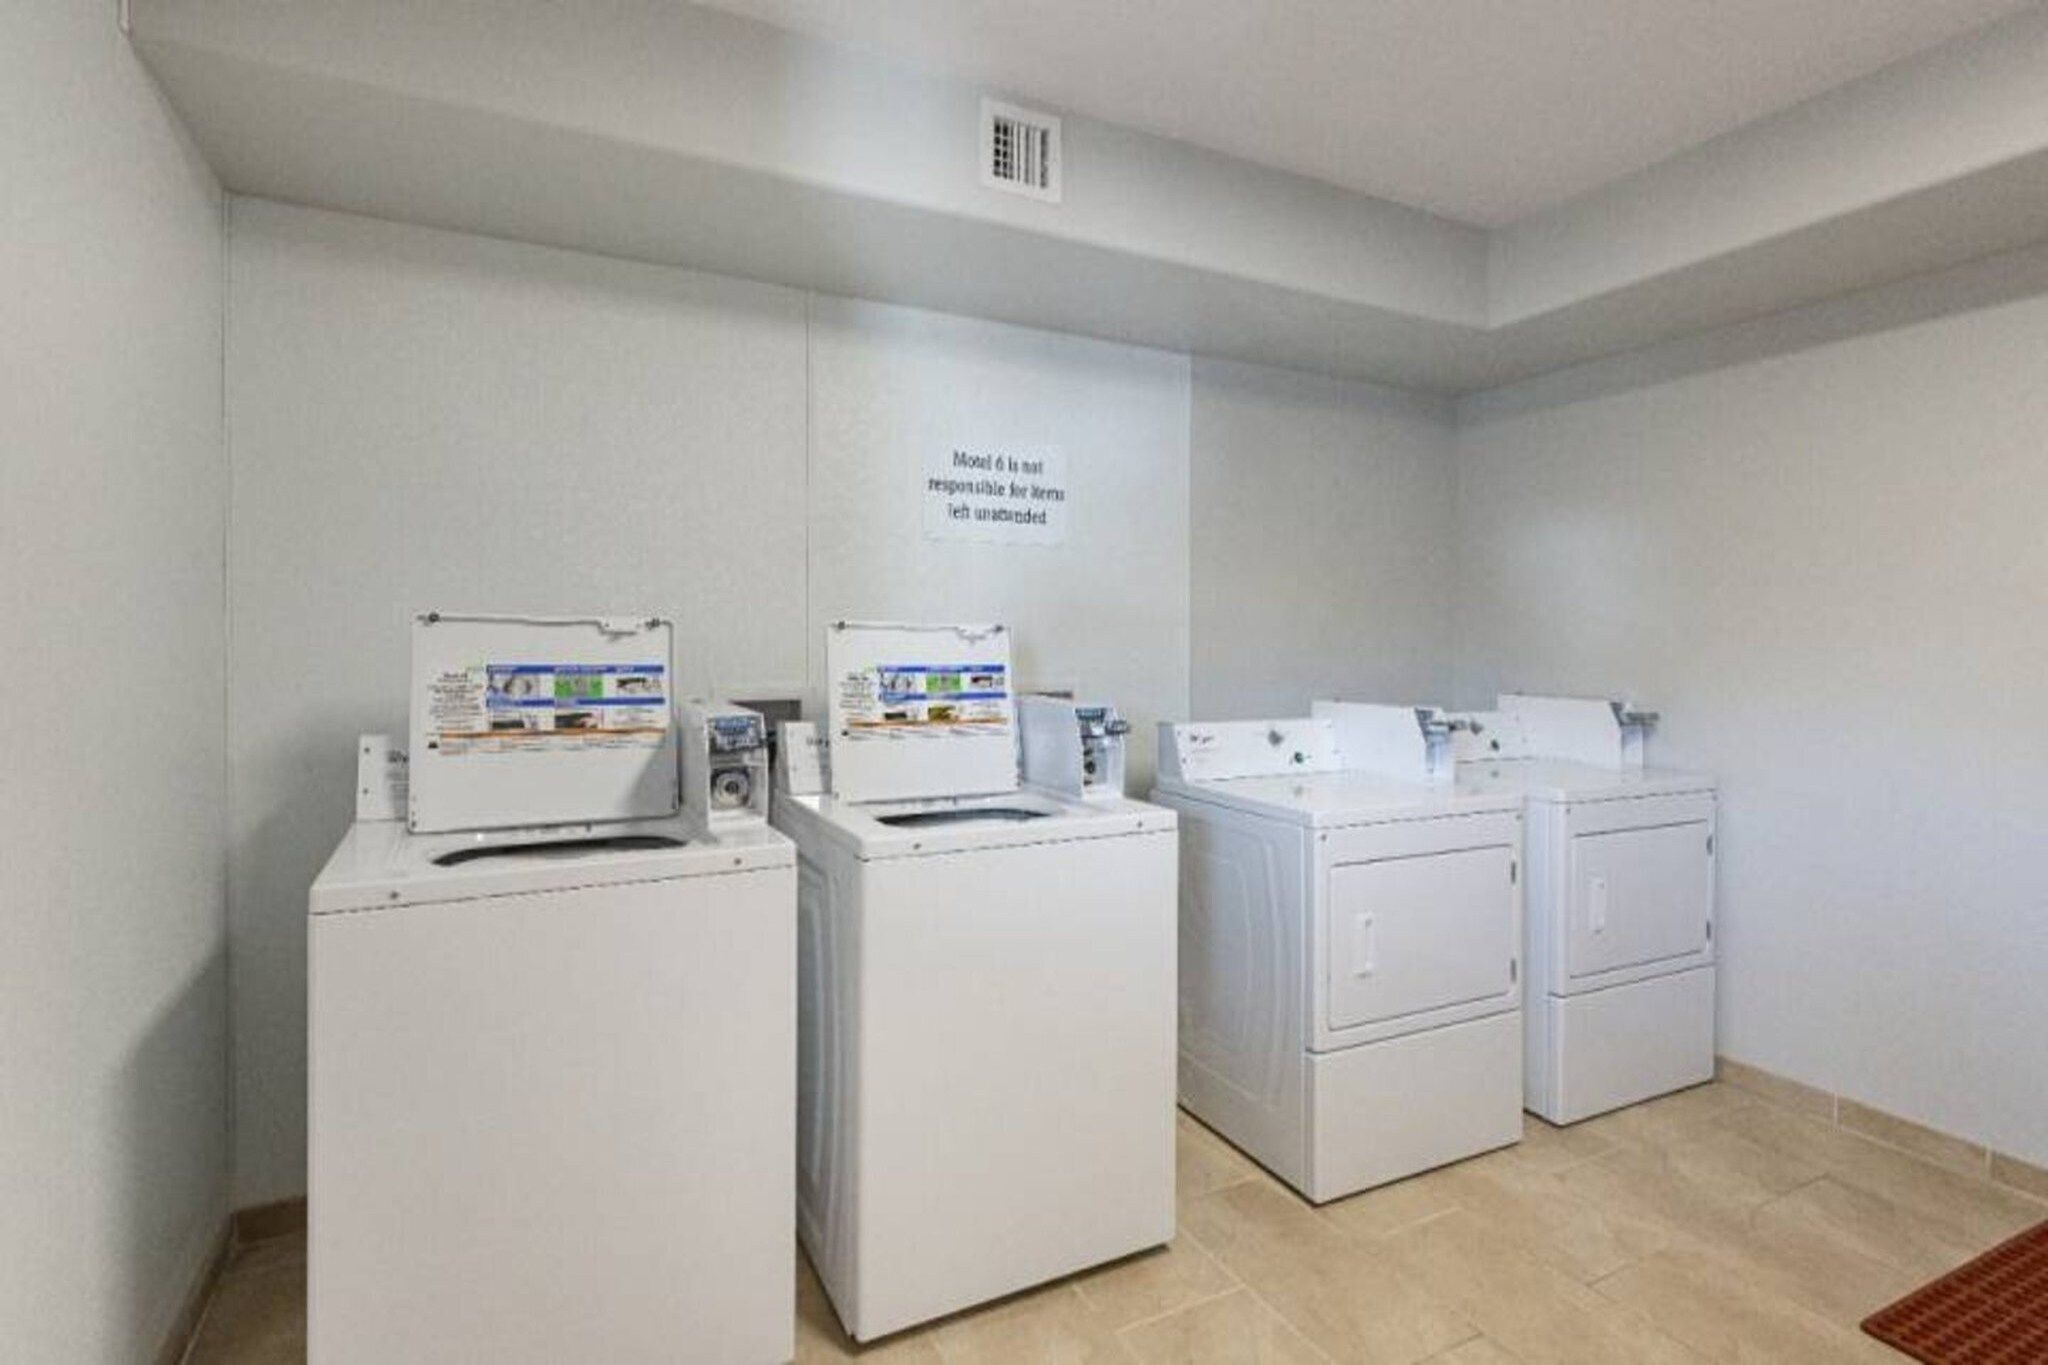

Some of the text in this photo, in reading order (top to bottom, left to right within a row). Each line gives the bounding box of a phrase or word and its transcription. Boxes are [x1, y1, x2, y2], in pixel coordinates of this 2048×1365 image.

[953, 449, 1044, 475] Motel 6 is not
[928, 477, 1065, 501] responsible for items
[947, 502, 1047, 524] left unattended
